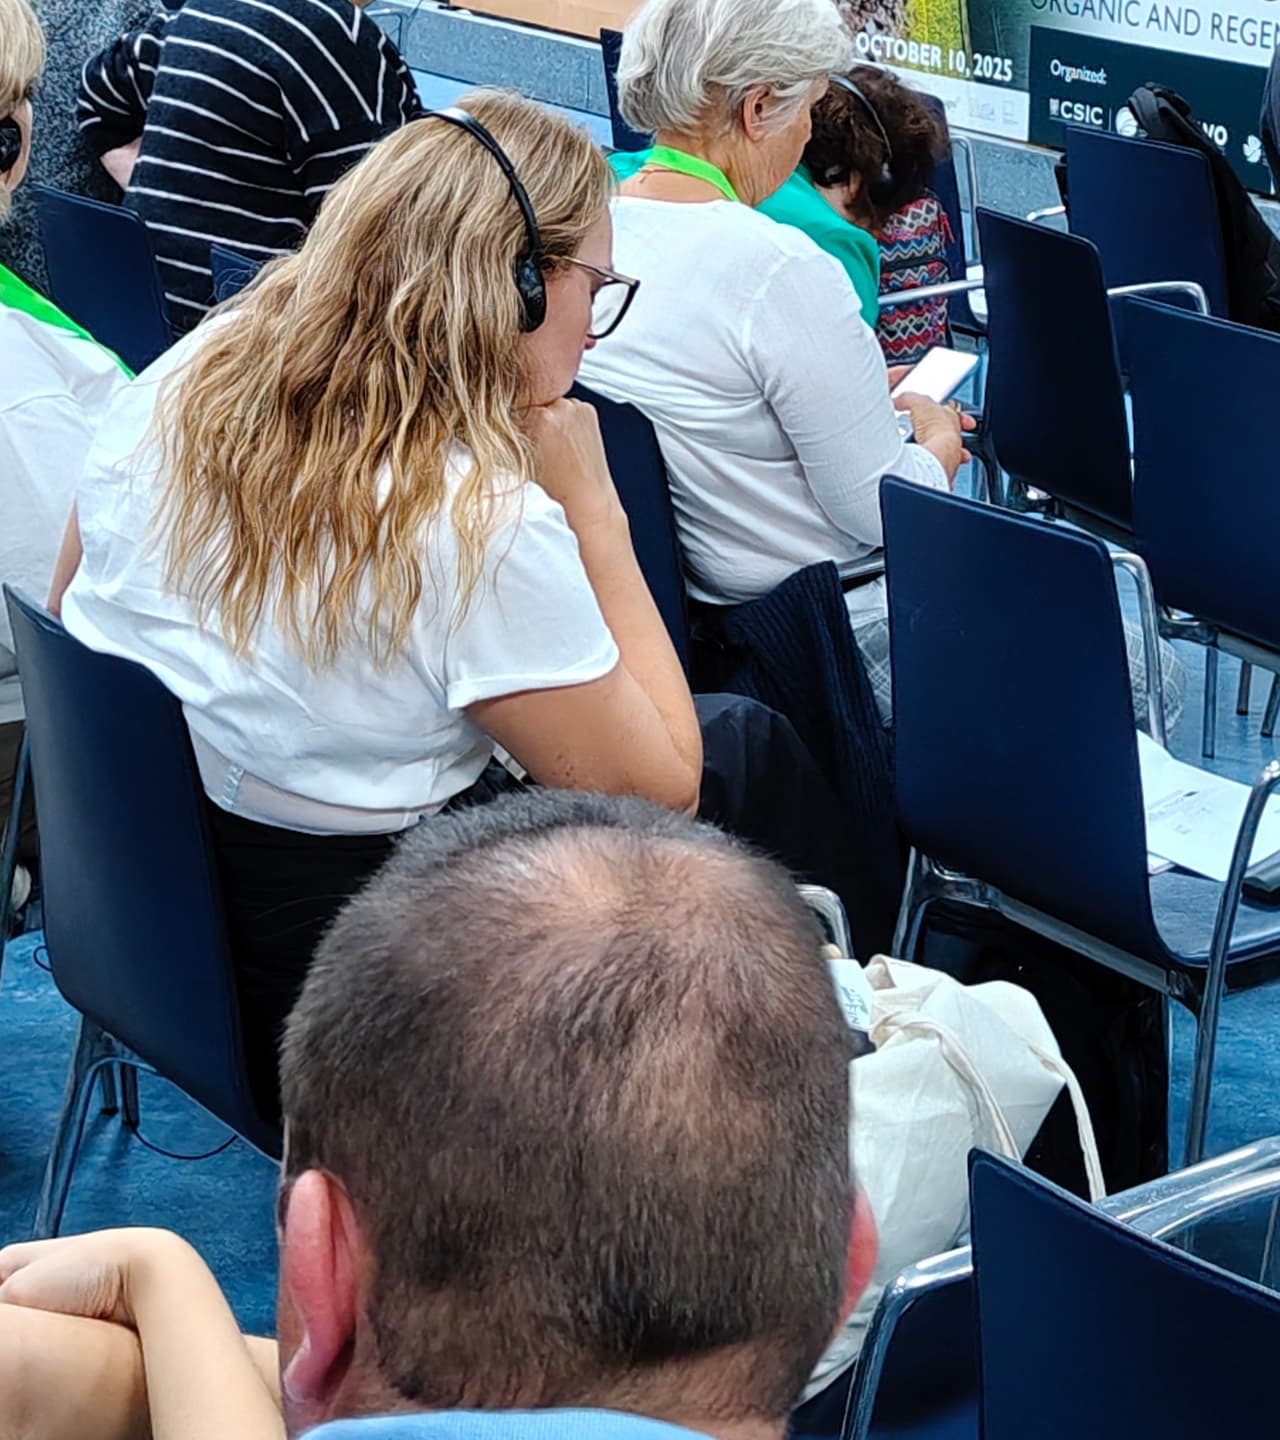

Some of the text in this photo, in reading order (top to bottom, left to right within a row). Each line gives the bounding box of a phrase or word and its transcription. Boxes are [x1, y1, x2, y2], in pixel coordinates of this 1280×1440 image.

[1146, 6, 1202, 38] AND
[855, 31, 1014, 83] OCTOBER 10, 2025
[1049, 58, 1108, 86] Organized:
[1059, 100, 1105, 126] CSIC
